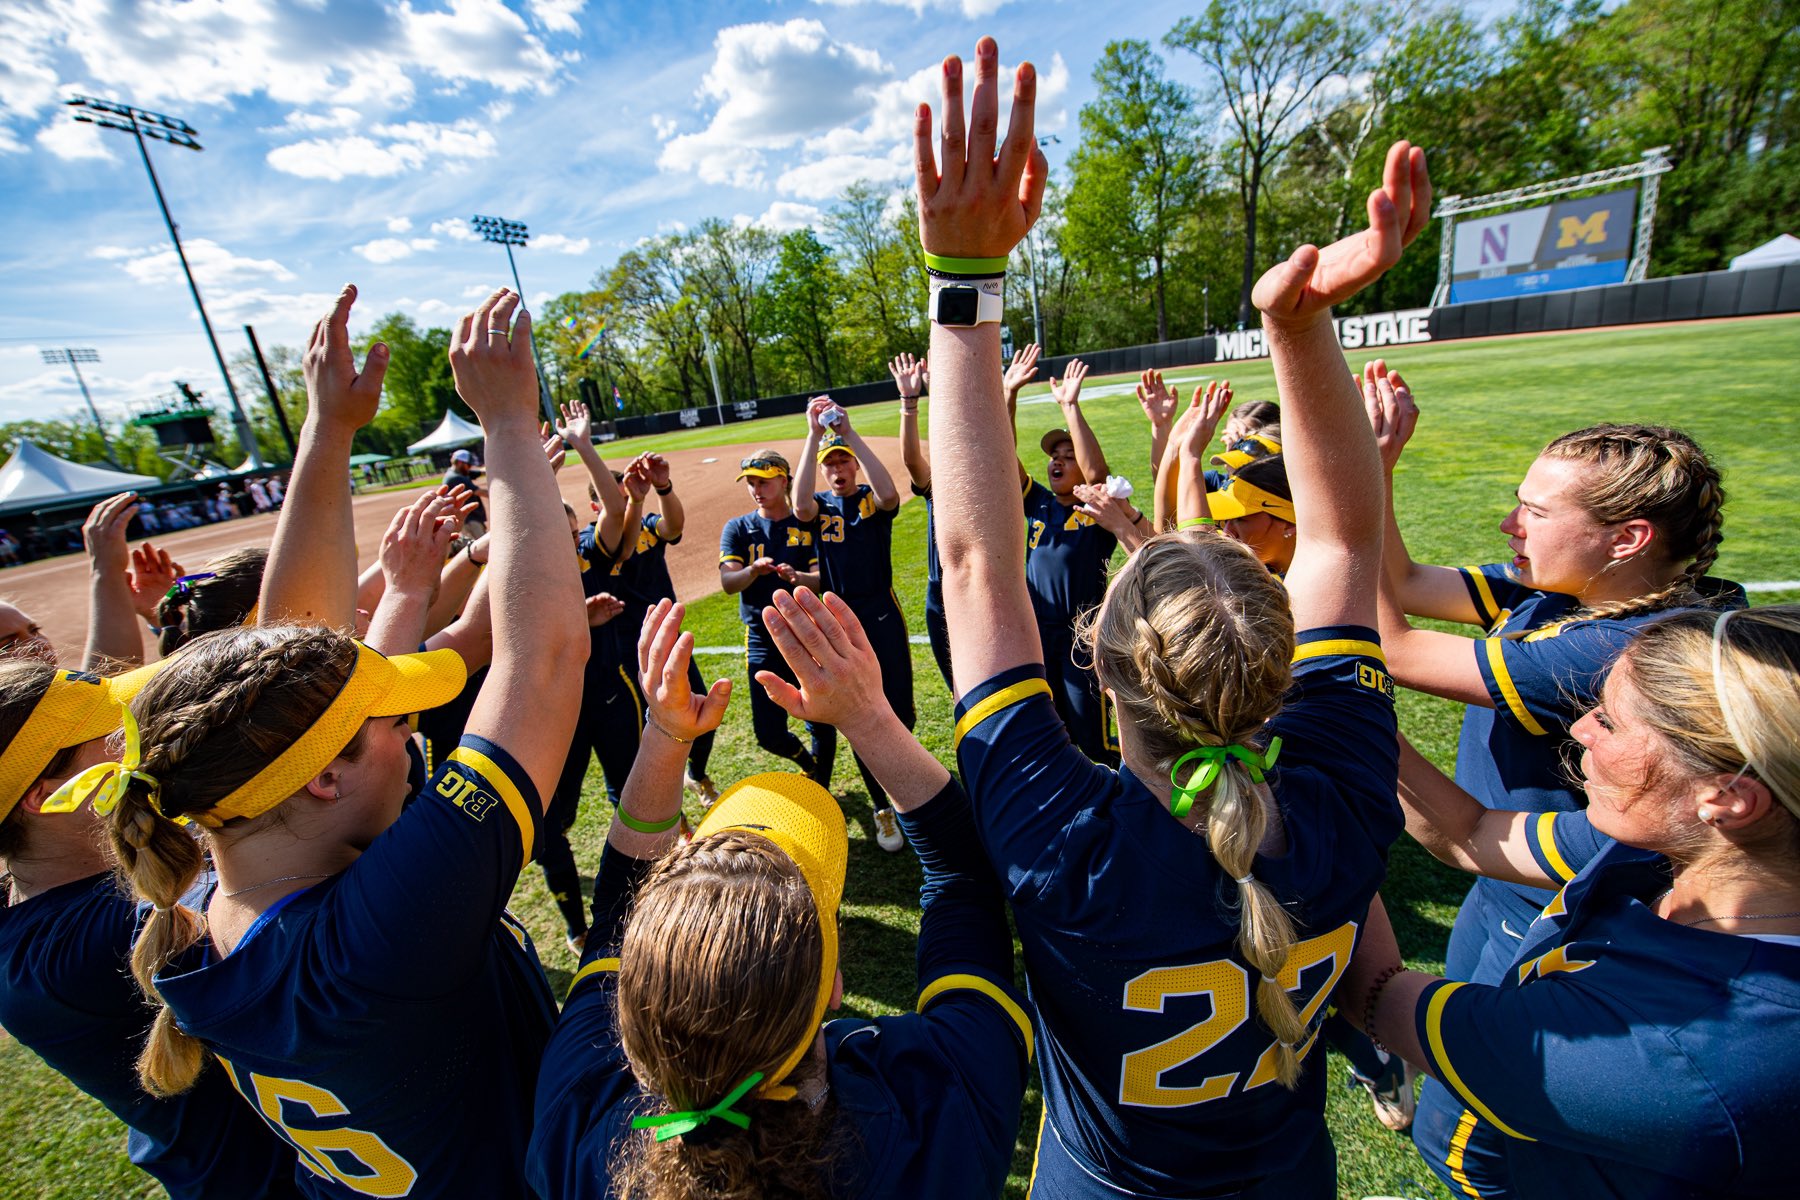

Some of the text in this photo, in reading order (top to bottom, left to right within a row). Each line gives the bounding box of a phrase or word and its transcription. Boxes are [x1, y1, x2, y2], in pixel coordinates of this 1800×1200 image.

[1480, 223, 1511, 265] N
[1556, 209, 1611, 250] M
[1341, 308, 1433, 349] STATE
[819, 513, 845, 543] 23
[748, 543, 765, 566] 11
